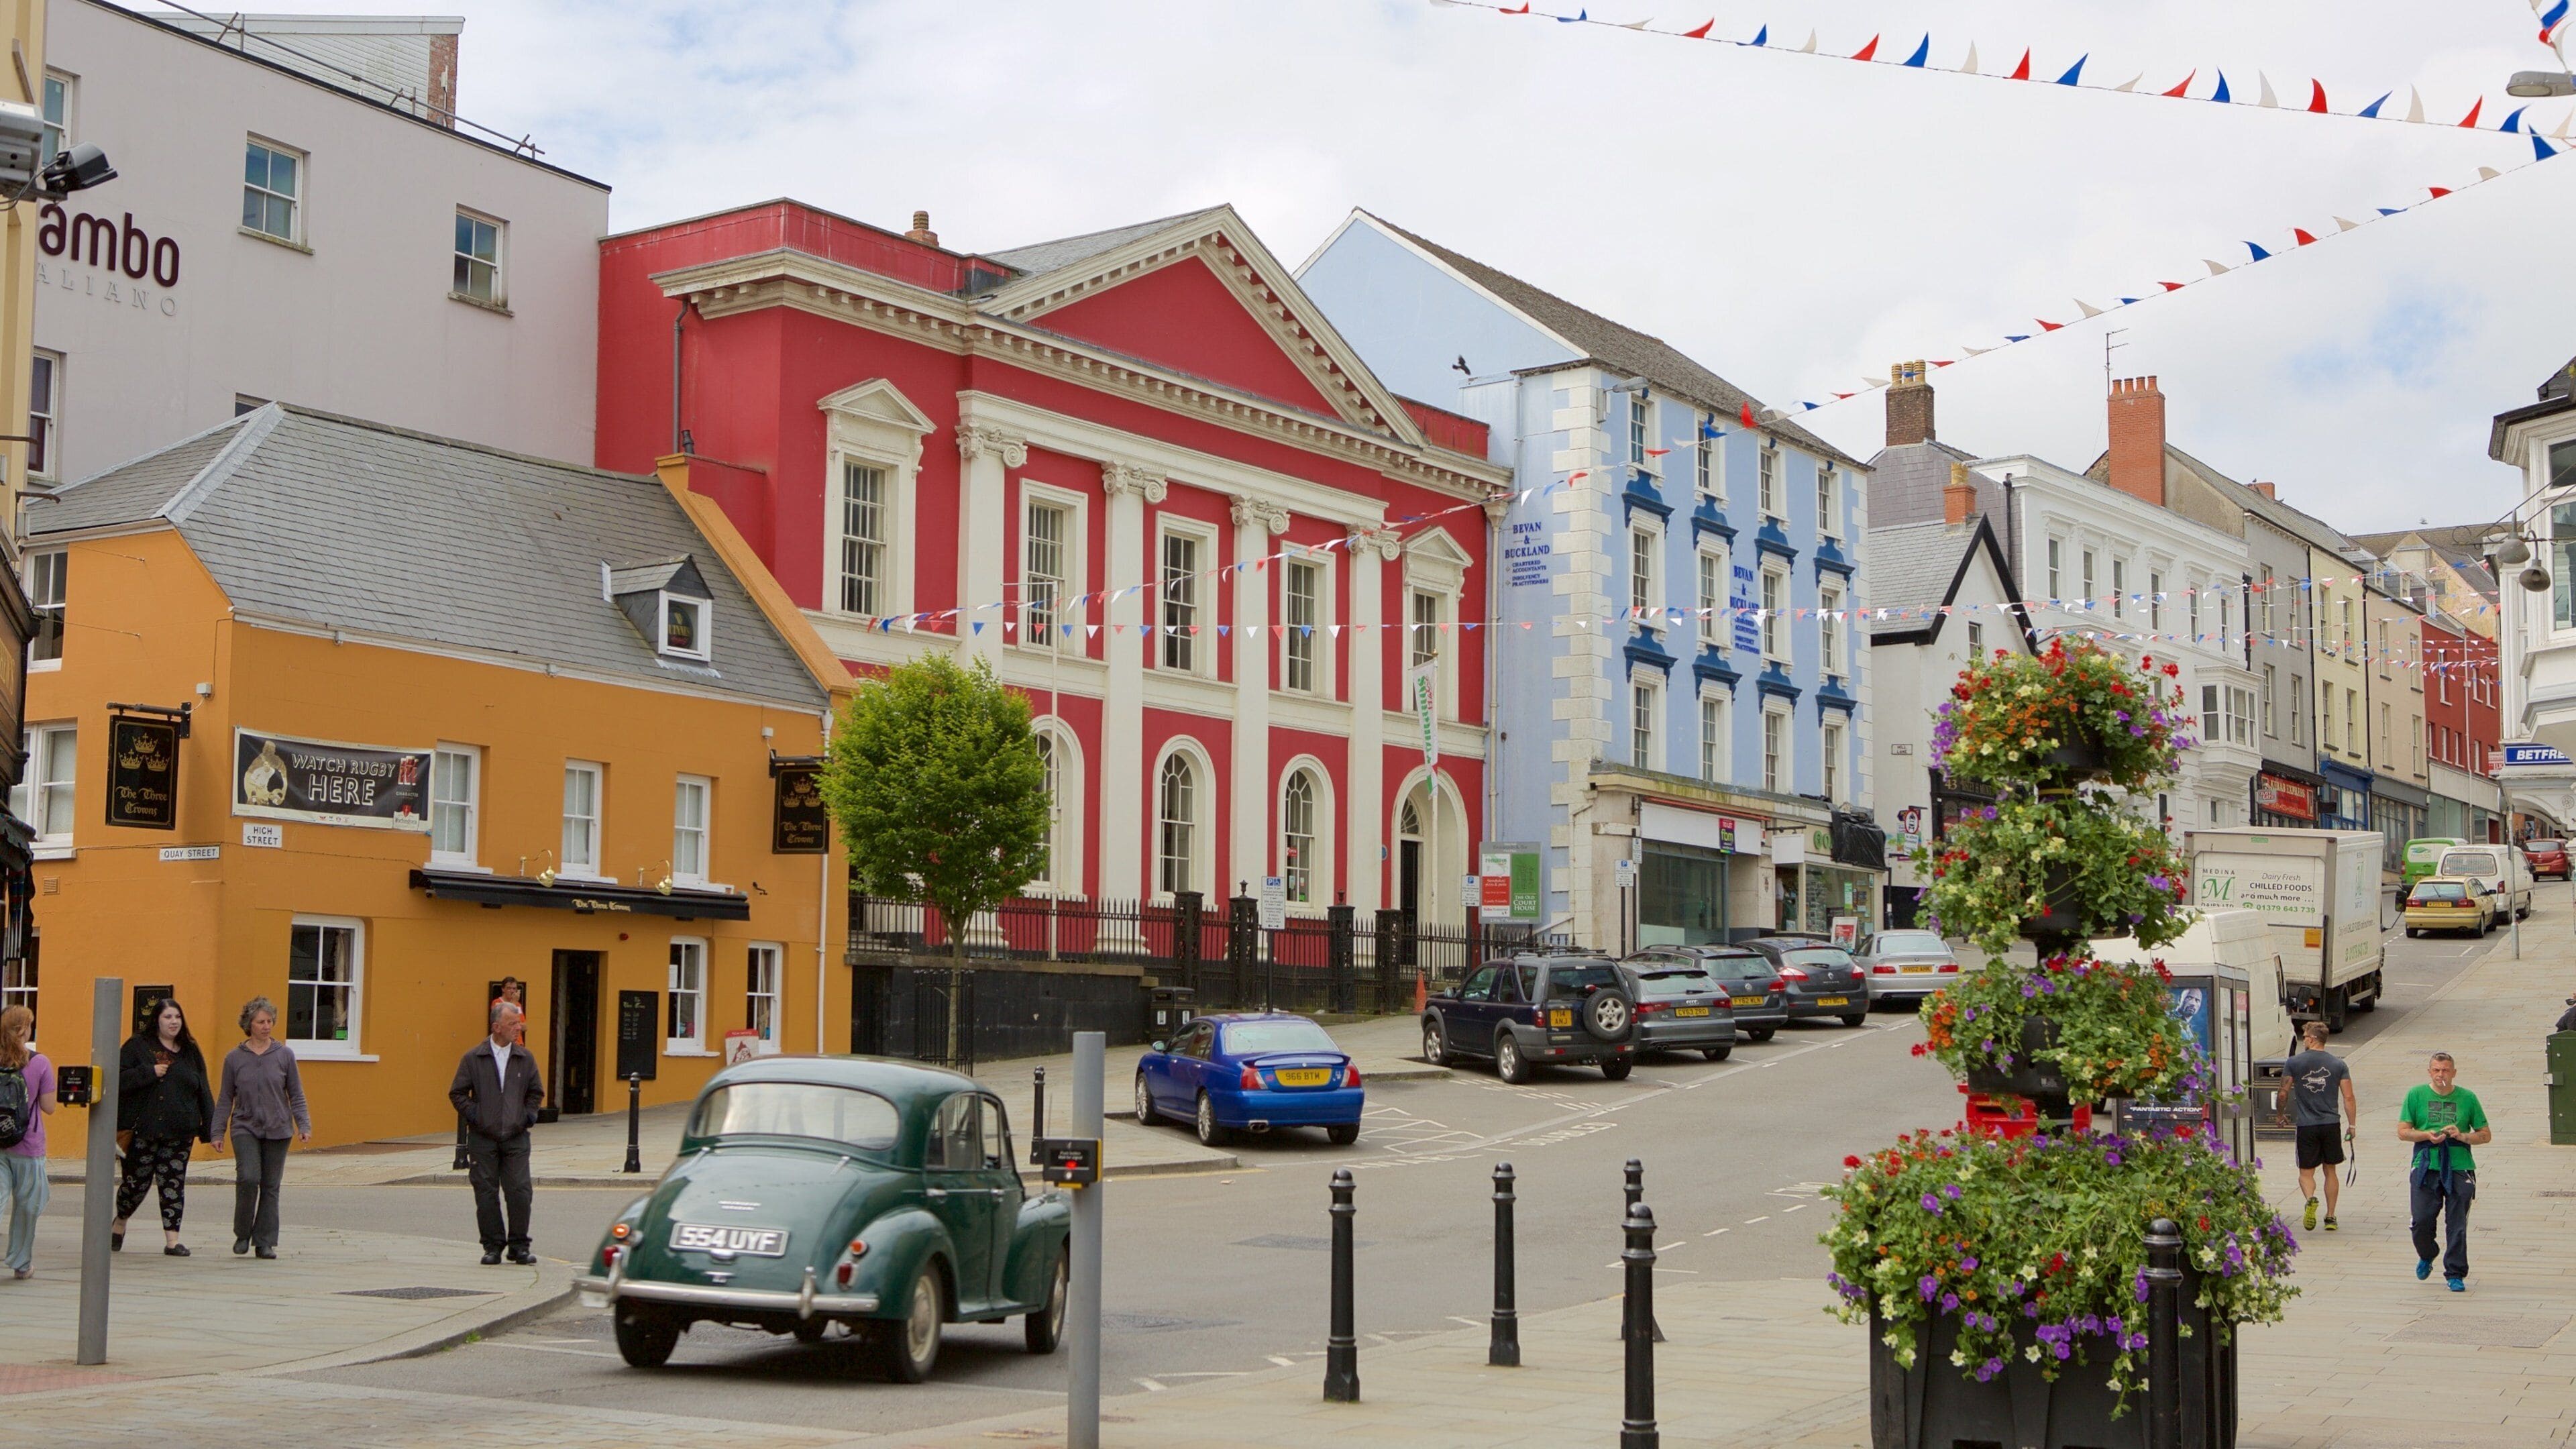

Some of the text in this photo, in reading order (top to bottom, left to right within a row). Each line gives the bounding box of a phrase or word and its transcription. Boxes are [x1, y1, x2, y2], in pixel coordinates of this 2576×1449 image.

[1513, 522, 1542, 534] BEVAN
[1523, 535, 1530, 545] &
[1505, 545, 1550, 559] BUCKLAND
[1512, 559, 1542, 568] CHARTERED
[1512, 566, 1547, 574] ACCOUNTANTS
[1733, 566, 1754, 582] BEVAN
[2516, 749, 2568, 761] BETFRE
[291, 753, 396, 777] WATCH RUGBY
[115, 786, 167, 801] The Three
[308, 773, 376, 806] HERE
[2286, 784, 2306, 798] EXPRESS
[124, 801, 158, 816] Crowns
[780, 821, 822, 831] The Three
[247, 835, 278, 845] STREET
[786, 833, 814, 844] Crowns
[164, 849, 216, 859] QUAY STREET
[2261, 873, 2281, 881] Dairy
[2201, 876, 2236, 900] M
[2249, 882, 2312, 892] CHILLED FOODS
[1285, 1072, 1302, 1081] 966
